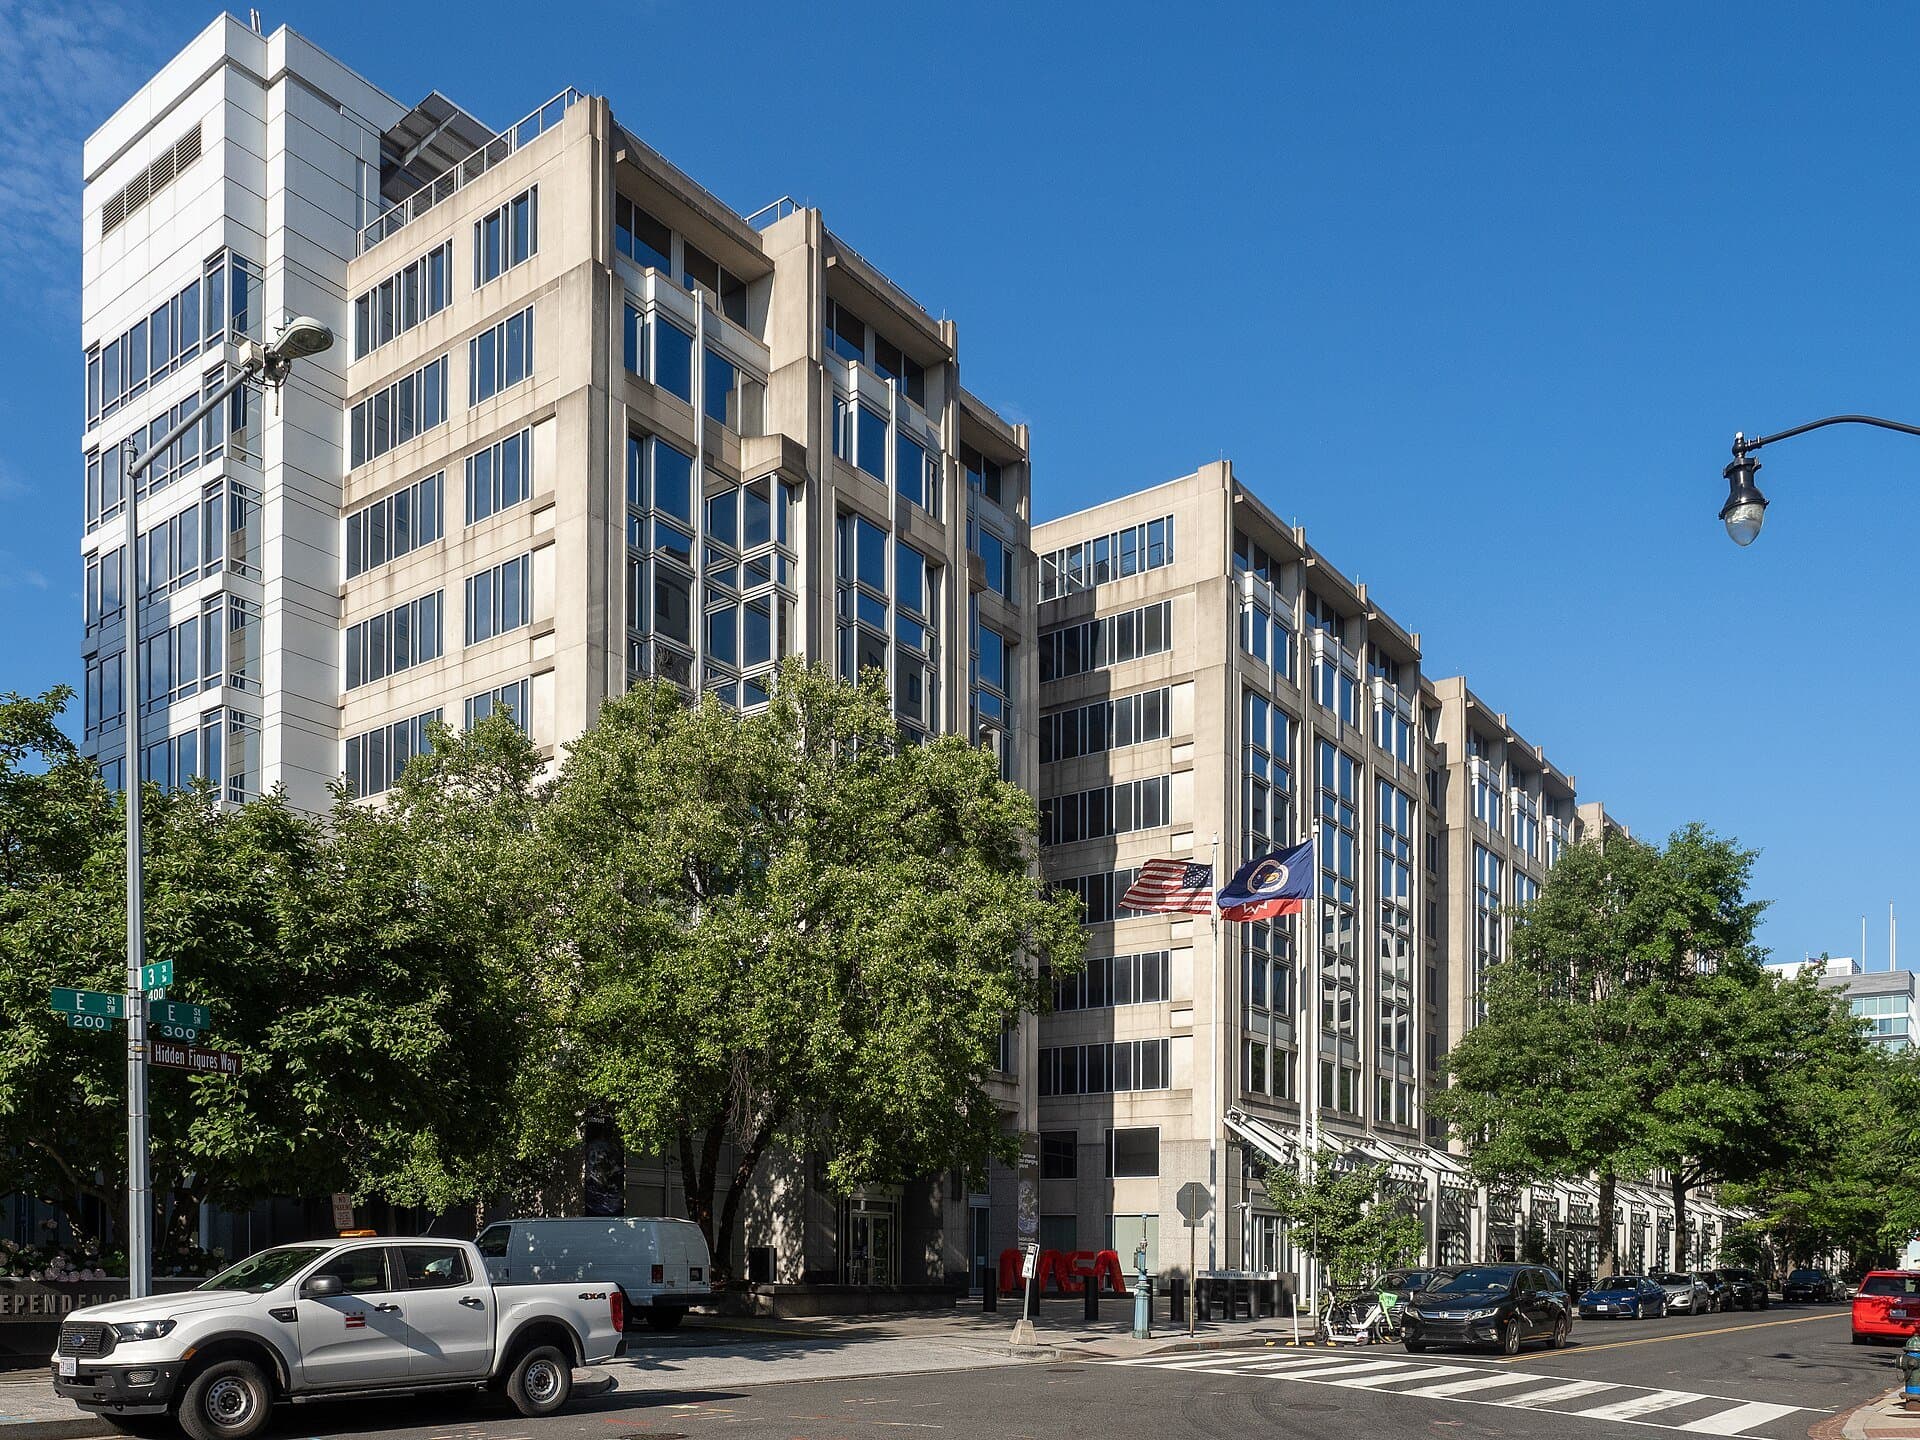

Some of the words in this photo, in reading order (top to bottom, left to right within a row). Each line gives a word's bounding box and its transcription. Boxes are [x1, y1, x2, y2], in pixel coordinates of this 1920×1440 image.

[148, 968, 155, 985] 3
[76, 992, 85, 1010] E
[106, 996, 115, 1005] St
[148, 987, 164, 1000] 400
[73, 1014, 104, 1028] 200
[168, 1004, 176, 1021] E
[163, 1025, 195, 1039] 300
[155, 1044, 185, 1065] Hidden
[188, 1049, 218, 1070] Figures
[220, 1053, 236, 1075] Way
[999, 1248, 1127, 1293] NASA
[0, 1294, 131, 1313] EPENDEN
